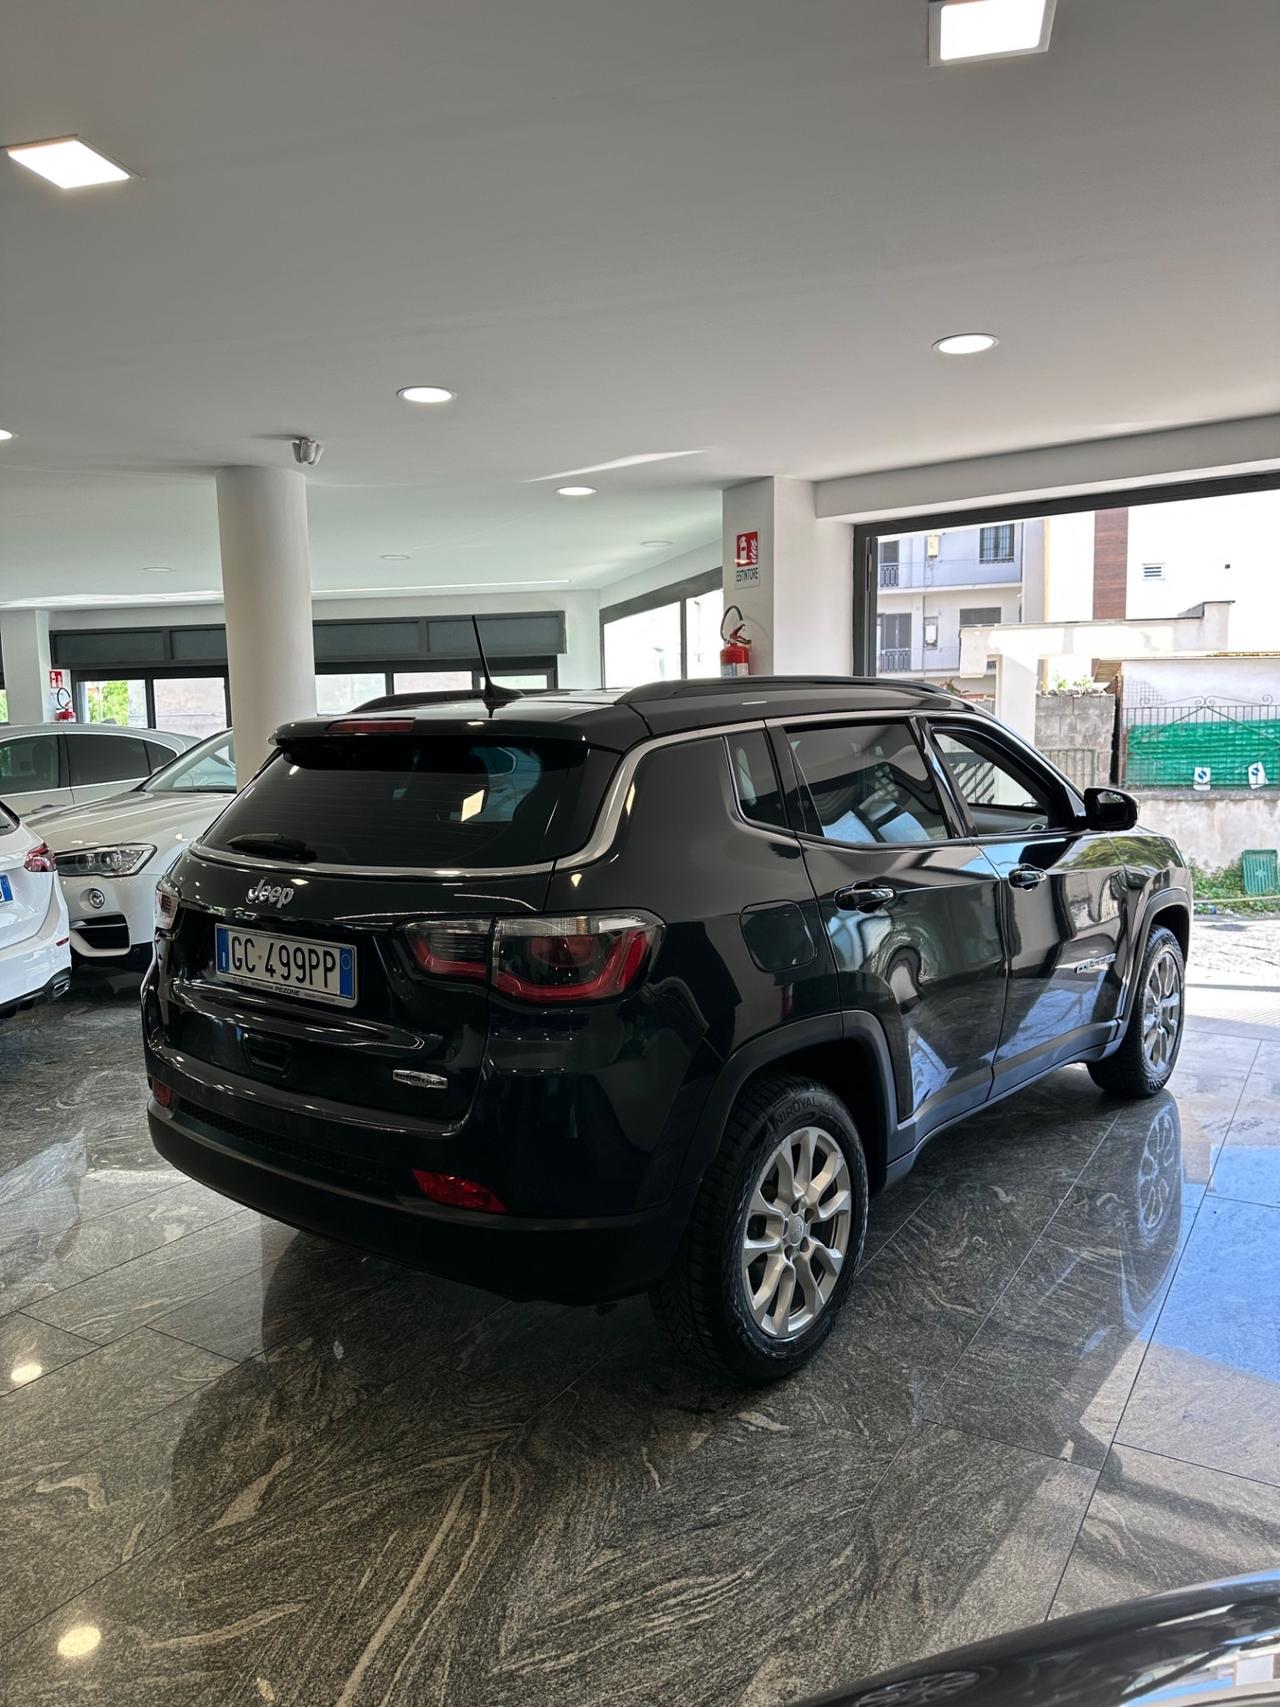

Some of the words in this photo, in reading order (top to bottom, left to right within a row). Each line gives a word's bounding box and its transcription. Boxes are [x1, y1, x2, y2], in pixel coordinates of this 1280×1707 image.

[736, 567, 759, 582] ESTINTORE
[248, 879, 294, 909] Jeep
[231, 935, 257, 973] GC
[265, 942, 336, 988] 499PP
